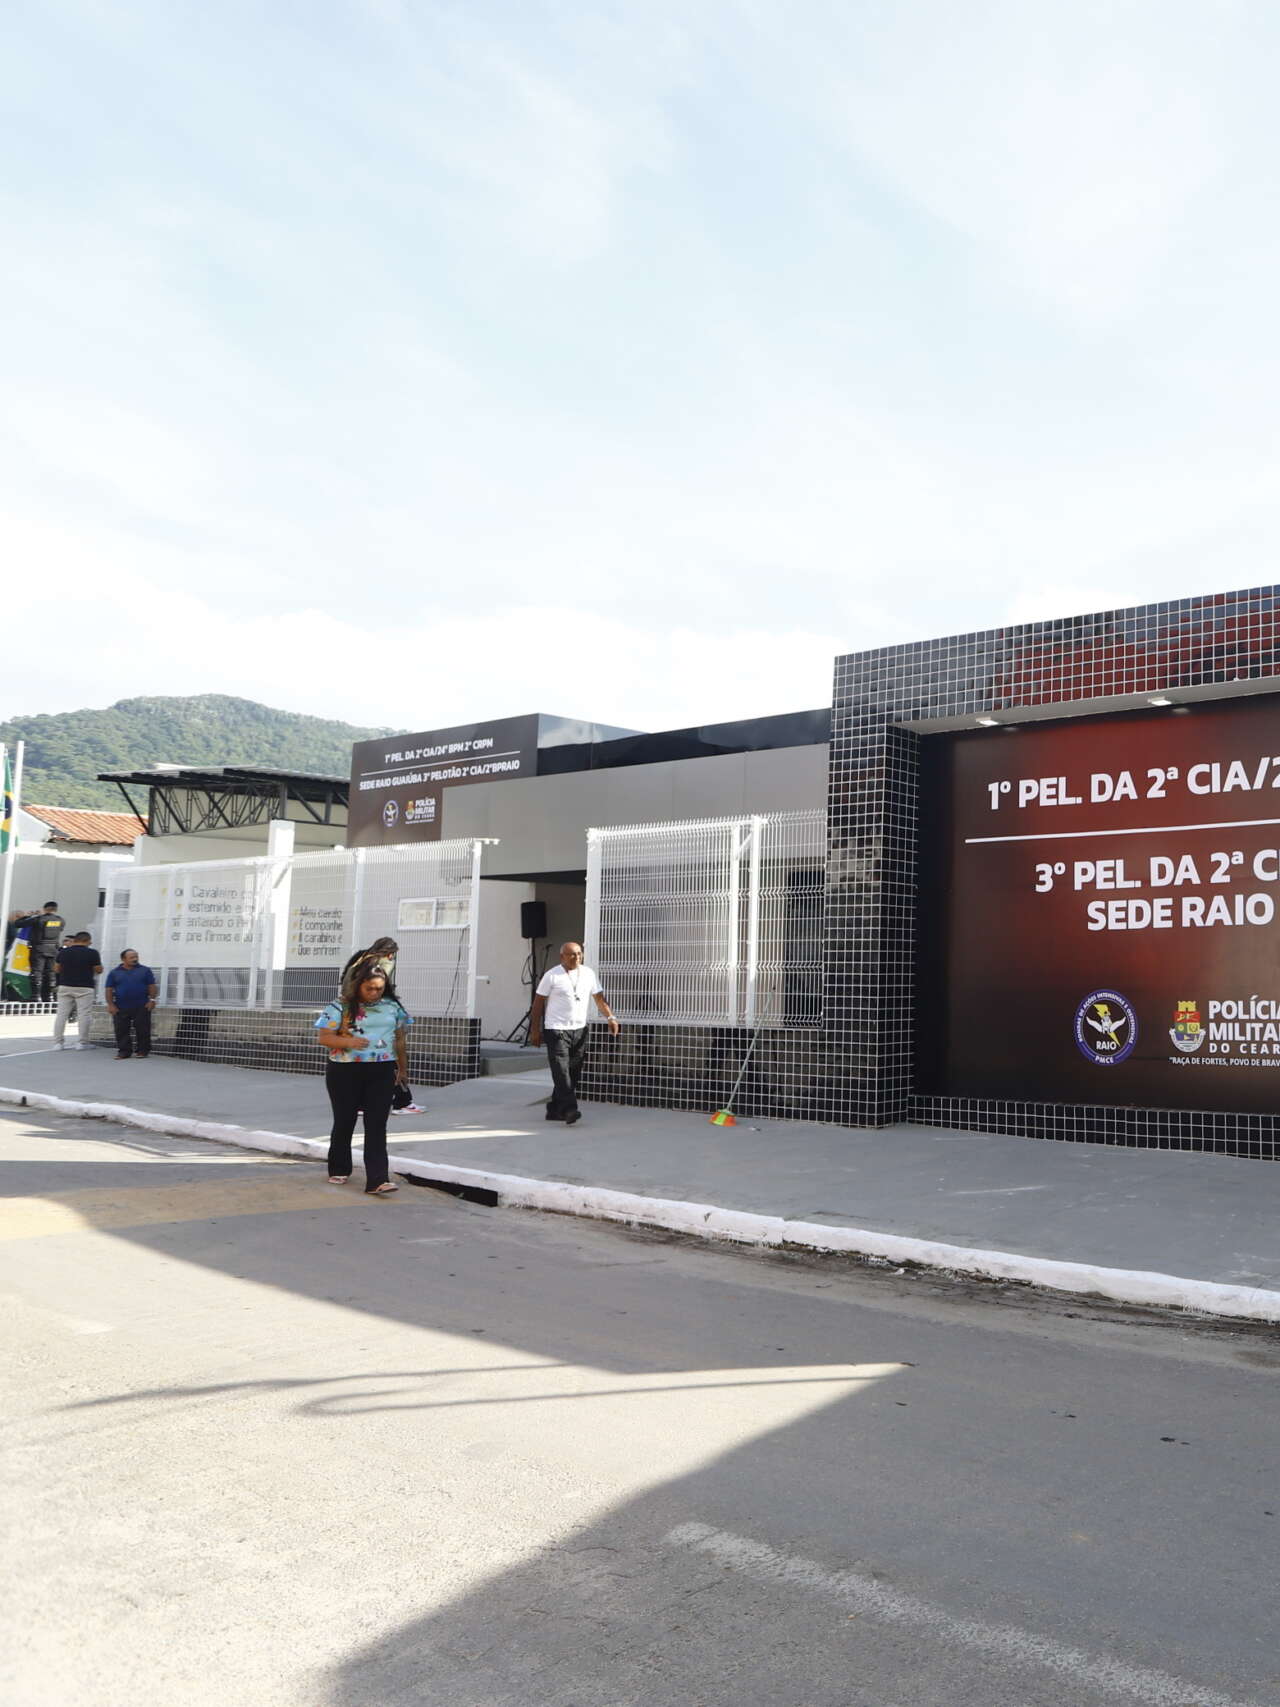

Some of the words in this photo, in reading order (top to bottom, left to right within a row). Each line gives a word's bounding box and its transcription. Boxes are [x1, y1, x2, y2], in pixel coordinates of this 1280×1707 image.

[405, 750, 415, 760] DA
[448, 742, 464, 754] BPM
[473, 738, 493, 749] CRPM
[359, 779, 375, 791] SEDE
[375, 777, 391, 789] RAIO
[430, 766, 462, 782] PELOTÃO
[988, 780, 1011, 810] 1º
[1018, 776, 1083, 808] PEL.
[1091, 771, 1138, 803] DA
[1147, 766, 1179, 798] 2ª
[1035, 862, 1066, 893] 3º
[1073, 859, 1141, 891] PEL.
[1150, 855, 1200, 887] DA
[1210, 850, 1244, 884] 2ª
[187, 902, 232, 914] estemido
[1087, 897, 1173, 931] SEDE
[1182, 893, 1274, 928] RAIO
[305, 920, 343, 931] companhe
[1096, 1040, 1117, 1050] RAIO
[1209, 1043, 1230, 1053] DO
[1095, 1055, 1114, 1064] PMCE
[1202, 1058, 1228, 1067] FORTES,
[1230, 1058, 1249, 1066] POVO
[1251, 1058, 1260, 1066] DE
